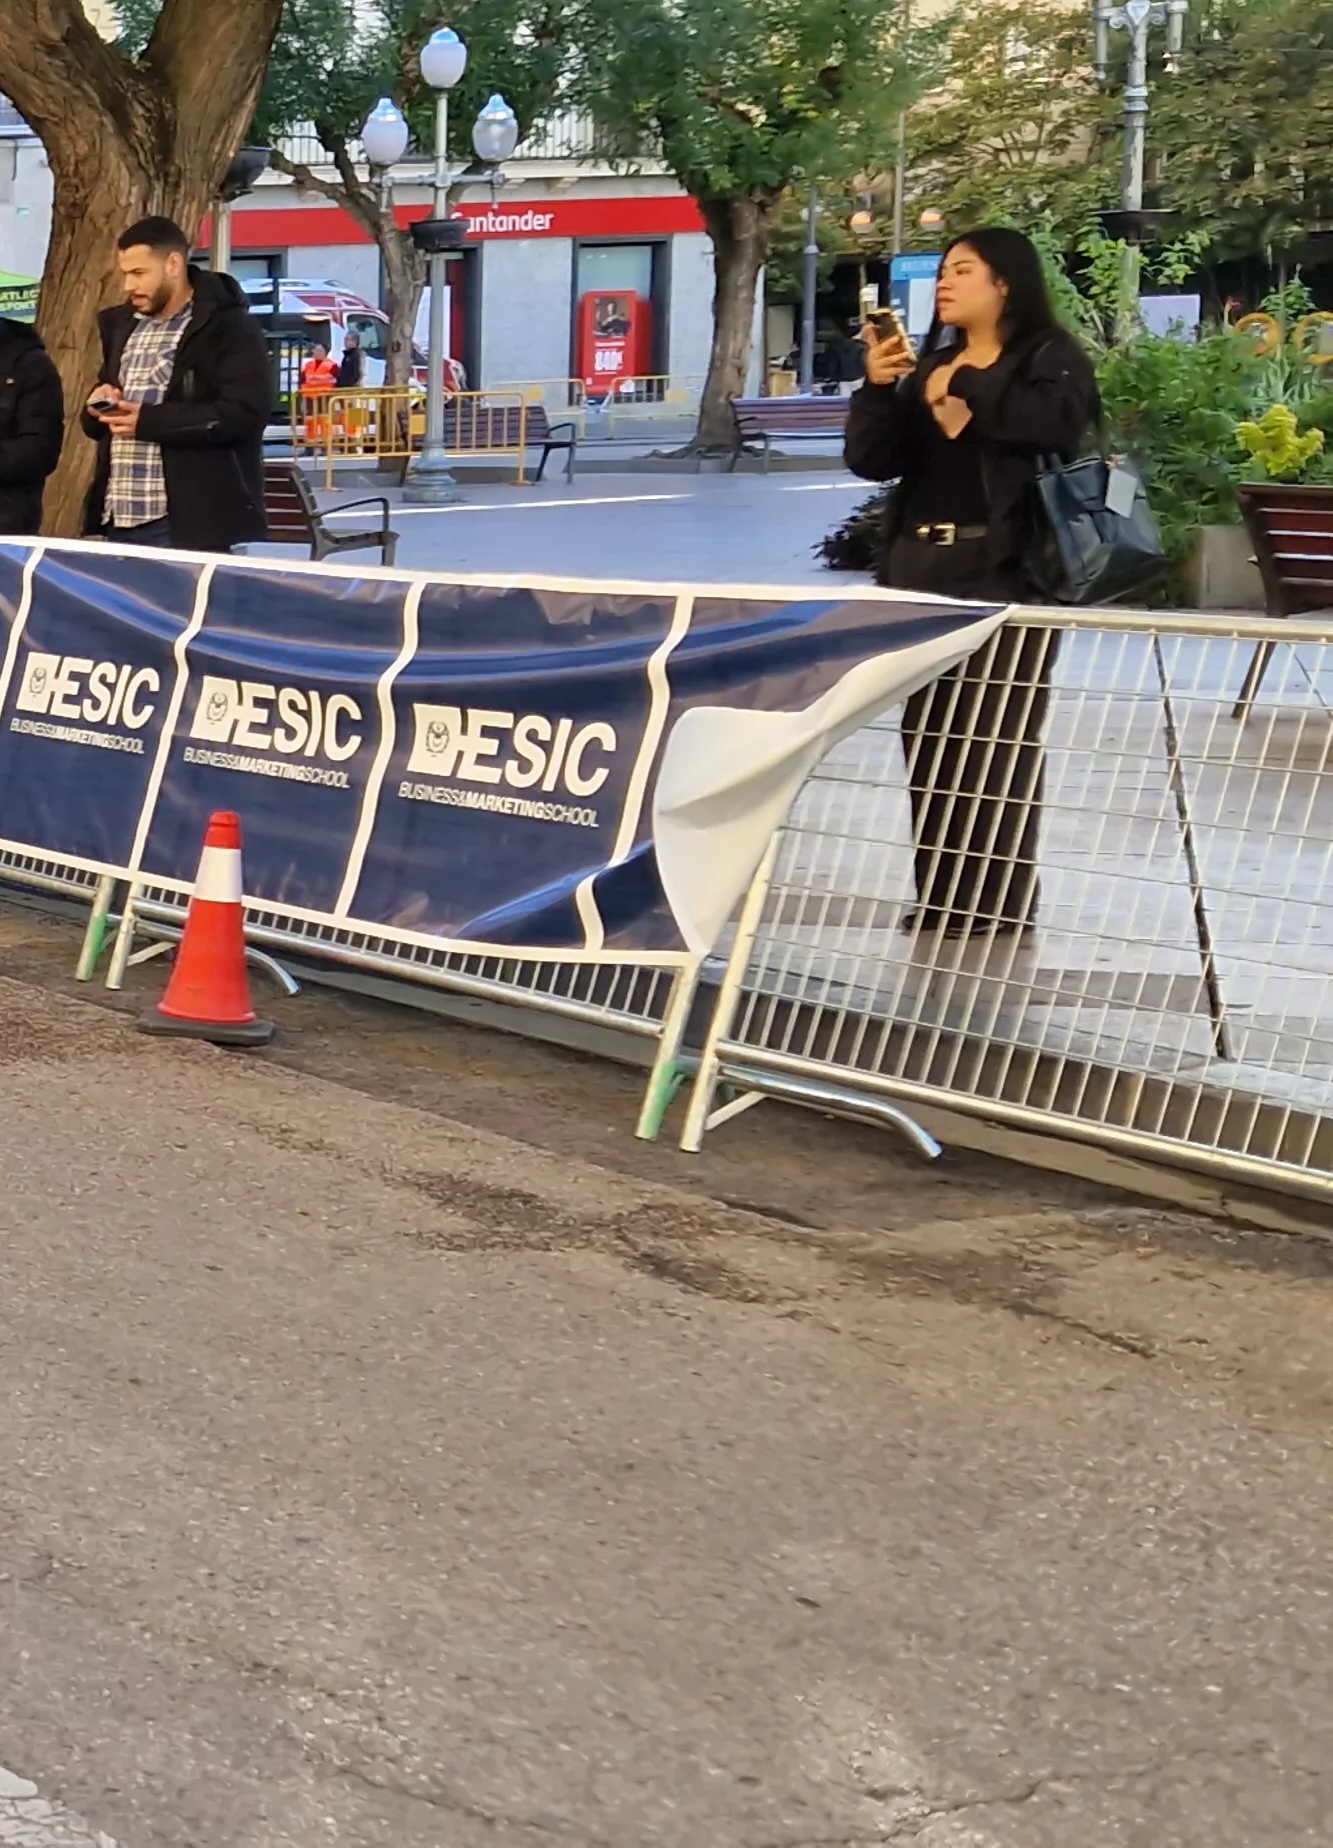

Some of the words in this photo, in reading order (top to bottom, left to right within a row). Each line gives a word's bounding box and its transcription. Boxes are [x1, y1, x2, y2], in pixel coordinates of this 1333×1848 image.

[49, 656, 161, 730] ESIC
[231, 681, 364, 761] ESIC
[183, 746, 351, 789] BUSINESS&MARKETINGSCHOOL
[455, 708, 617, 797] ESIC
[397, 780, 600, 828] BUSINESS&MARKETINGSCHOOL
